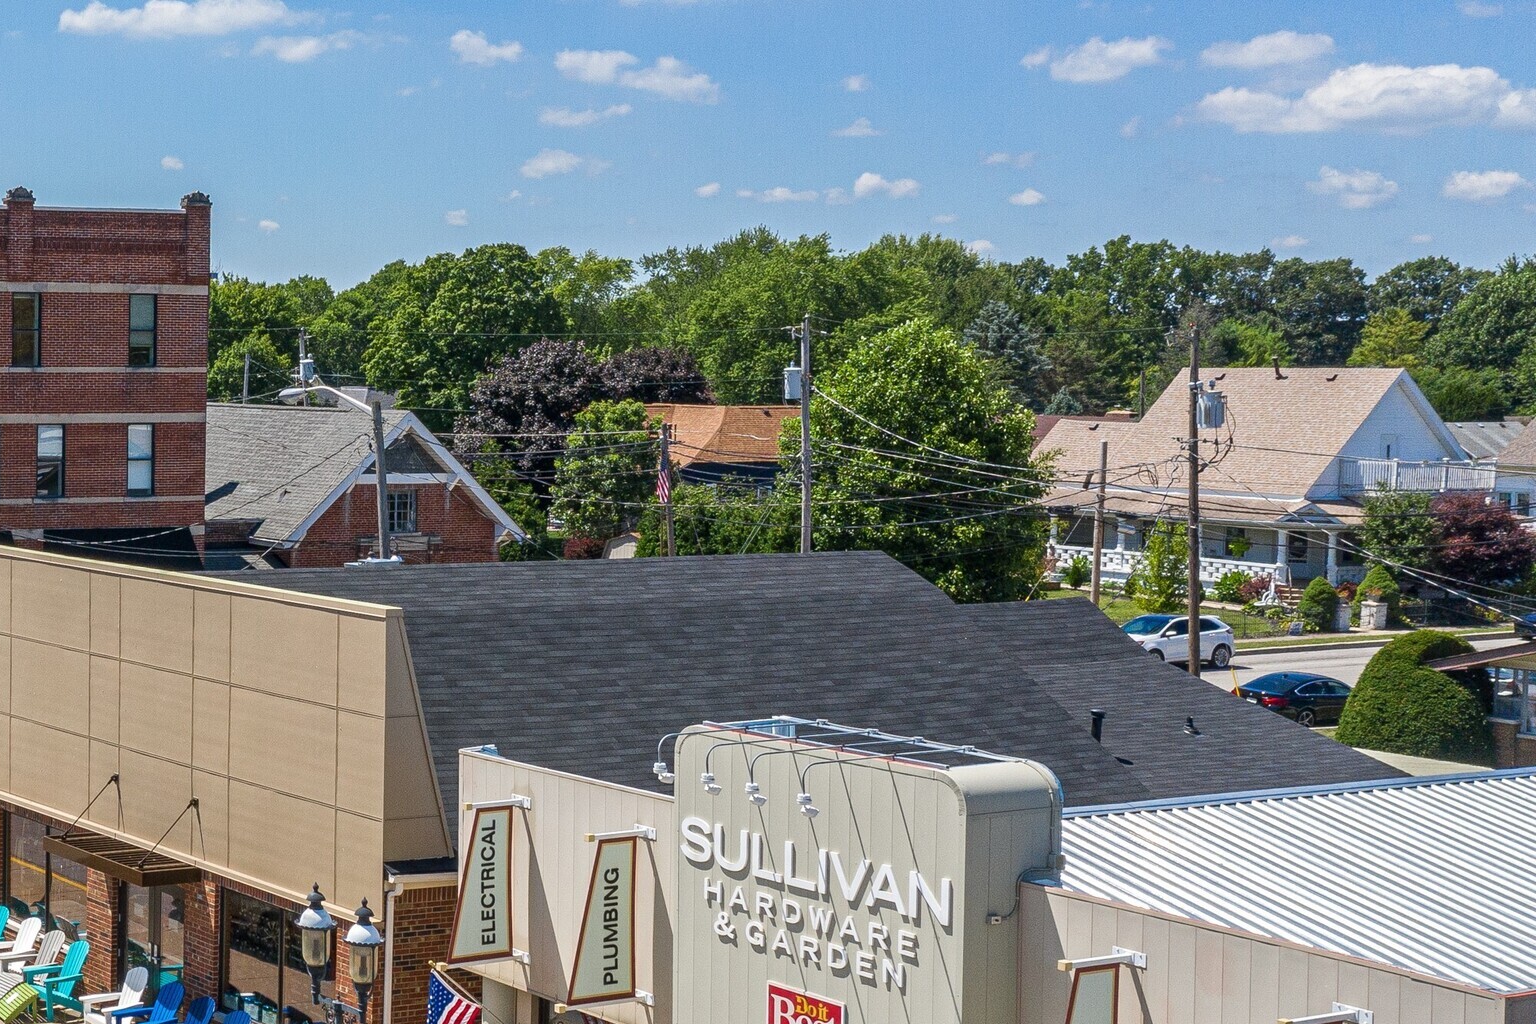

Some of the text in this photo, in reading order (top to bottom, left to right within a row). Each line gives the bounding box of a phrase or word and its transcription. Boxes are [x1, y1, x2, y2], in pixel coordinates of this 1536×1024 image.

[481, 819, 496, 945] ELECTRICAL
[680, 816, 951, 927] SULLIVAN
[703, 877, 917, 958] HARDWARE
[603, 867, 619, 986] PLUMBING
[713, 911, 905, 988] & GARDEN
[795, 995, 829, 1022] Do it
